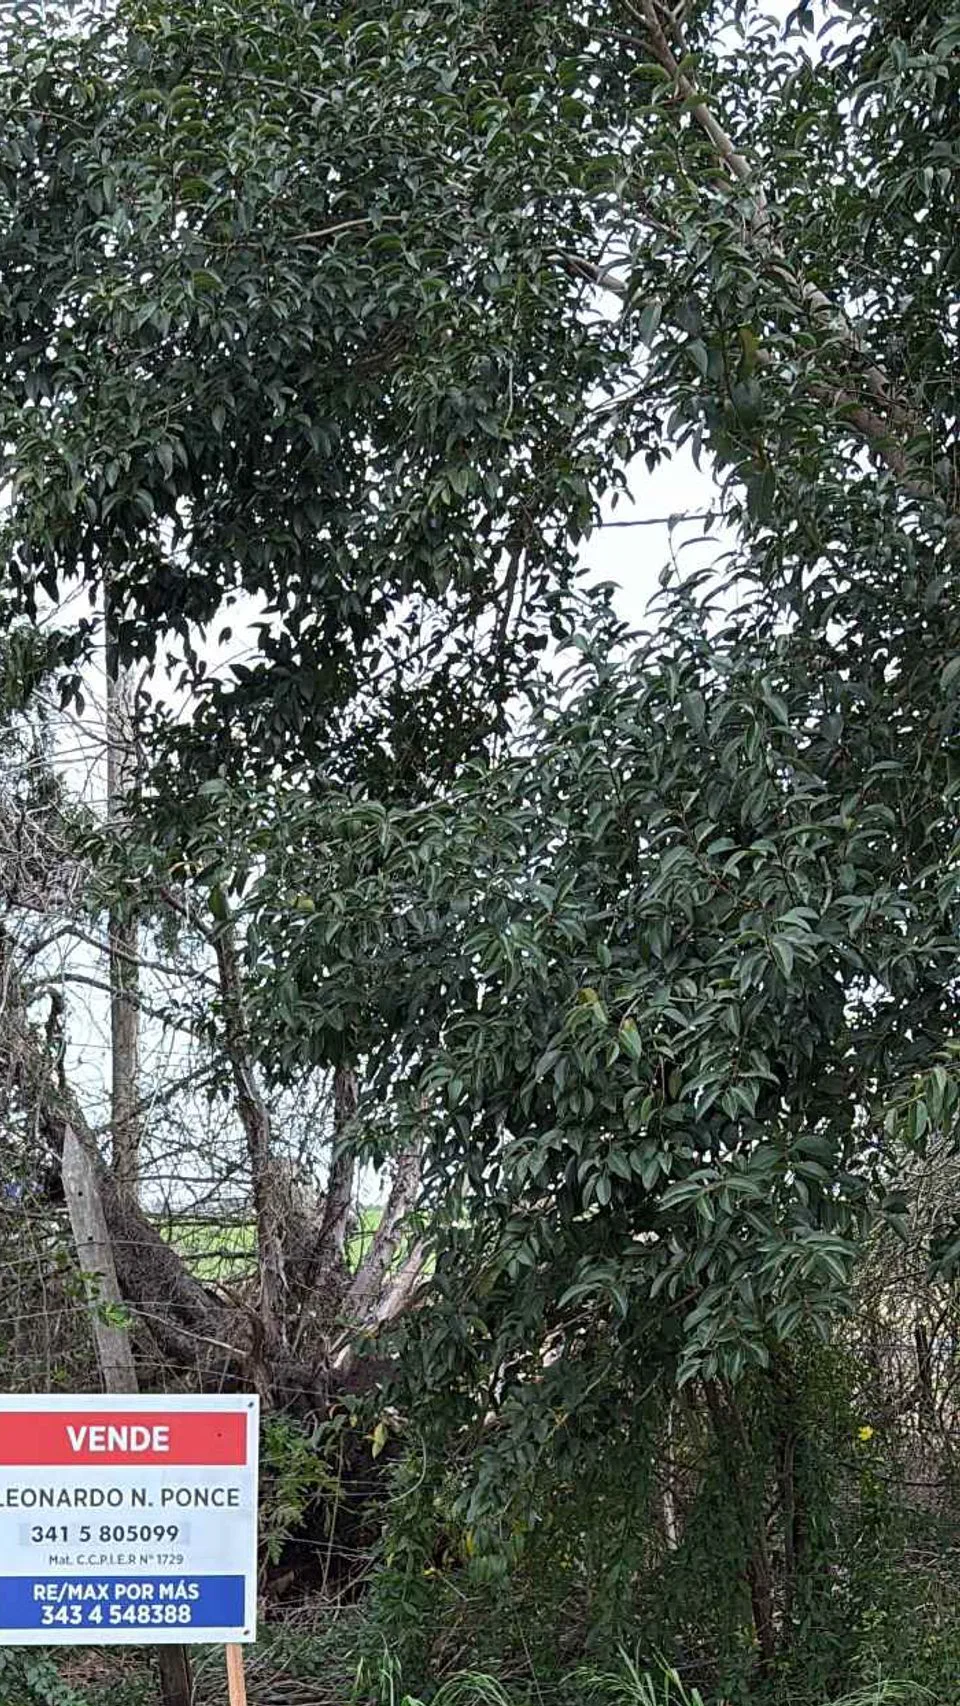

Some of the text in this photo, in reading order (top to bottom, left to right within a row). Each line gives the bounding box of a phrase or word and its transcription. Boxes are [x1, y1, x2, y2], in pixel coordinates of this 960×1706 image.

[66, 1425, 170, 1452] VENDE
[131, 1488, 153, 1507] N.
[161, 1487, 240, 1507] PONCE
[31, 1525, 179, 1543] 341 5 805099
[49, 1554, 72, 1566] Mat.
[157, 1553, 184, 1565] 1729
[33, 1580, 199, 1602] RE/MAX POR MÁS
[41, 1604, 192, 1625] 343 4 548388
